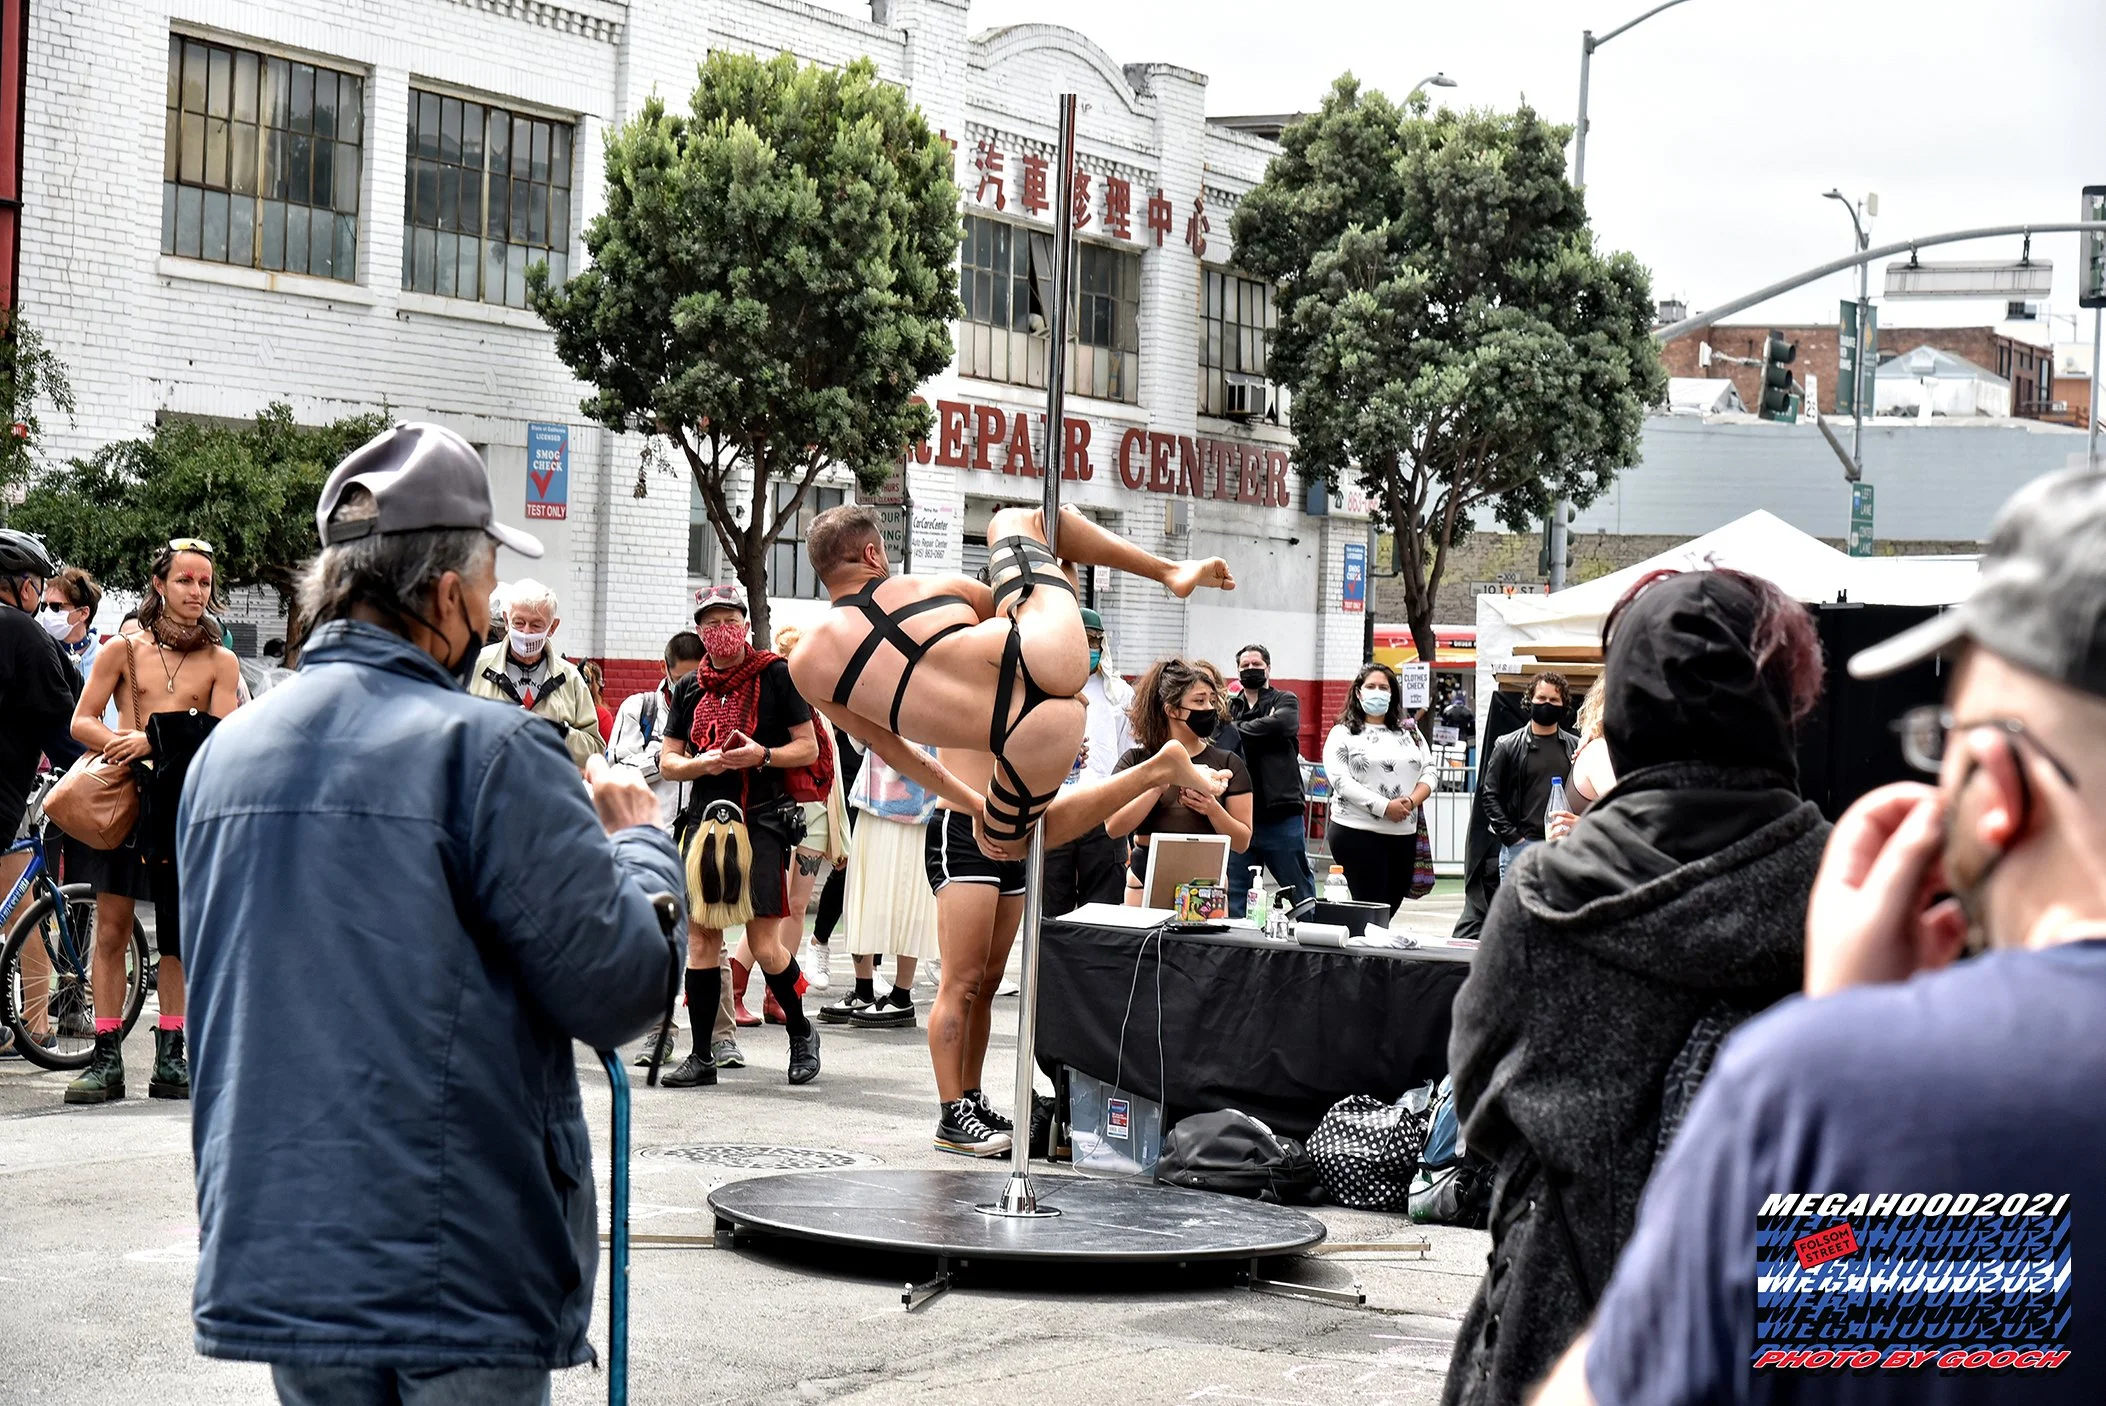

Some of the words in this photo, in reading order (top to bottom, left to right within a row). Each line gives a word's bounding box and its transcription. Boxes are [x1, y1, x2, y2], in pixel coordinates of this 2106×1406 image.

[536, 433, 561, 442] LICENSED
[536, 449, 560, 460] SMOG
[904, 394, 1093, 481] EPAR
[1119, 427, 1290, 508] CENTER
[533, 460, 563, 472] CHECK
[527, 504, 546, 516] TEST
[546, 505, 566, 517] ONLY
[1860, 504, 1872, 516] LANE
[881, 511, 900, 523] OUR
[1404, 674, 1428, 682] CLOTHES
[1407, 682, 1425, 690] CHECK
